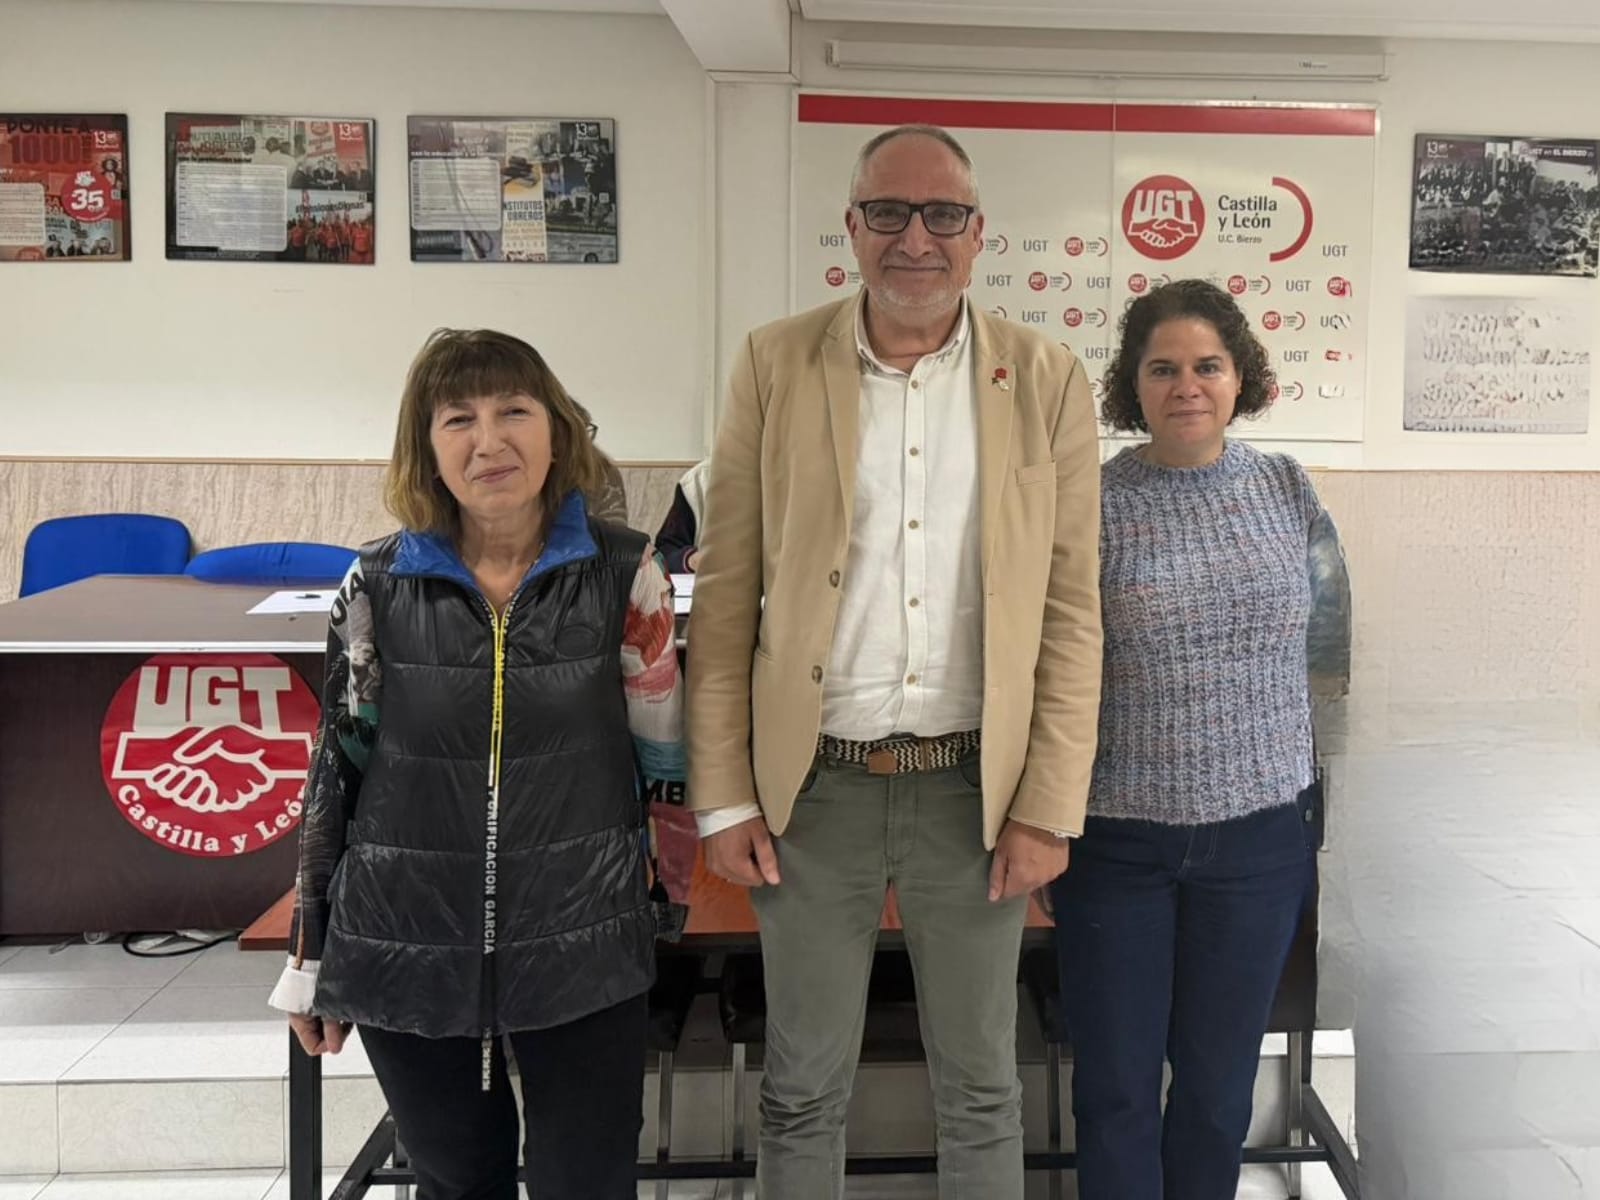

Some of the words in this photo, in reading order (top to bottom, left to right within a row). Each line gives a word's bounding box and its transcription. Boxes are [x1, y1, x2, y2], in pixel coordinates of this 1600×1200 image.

[71, 188, 104, 210] 35
[1218, 195, 1278, 211] Castilla
[1131, 190, 1195, 222] UGT
[1218, 216, 1227, 232] y
[1233, 213, 1271, 228] León
[820, 234, 846, 247] UGT
[1023, 240, 1049, 252] UGT
[1322, 245, 1347, 257] UGT
[987, 275, 1012, 287] UGT
[1087, 277, 1111, 289] UGT
[1286, 280, 1311, 292] UGT
[1022, 311, 1047, 323] UGT
[1085, 347, 1110, 359] UGT
[1284, 351, 1309, 362] UGT
[133, 666, 292, 735] UGT
[118, 785, 220, 852] Castilla
[230, 834, 248, 854] y
[483, 900, 496, 955] GARCIA
